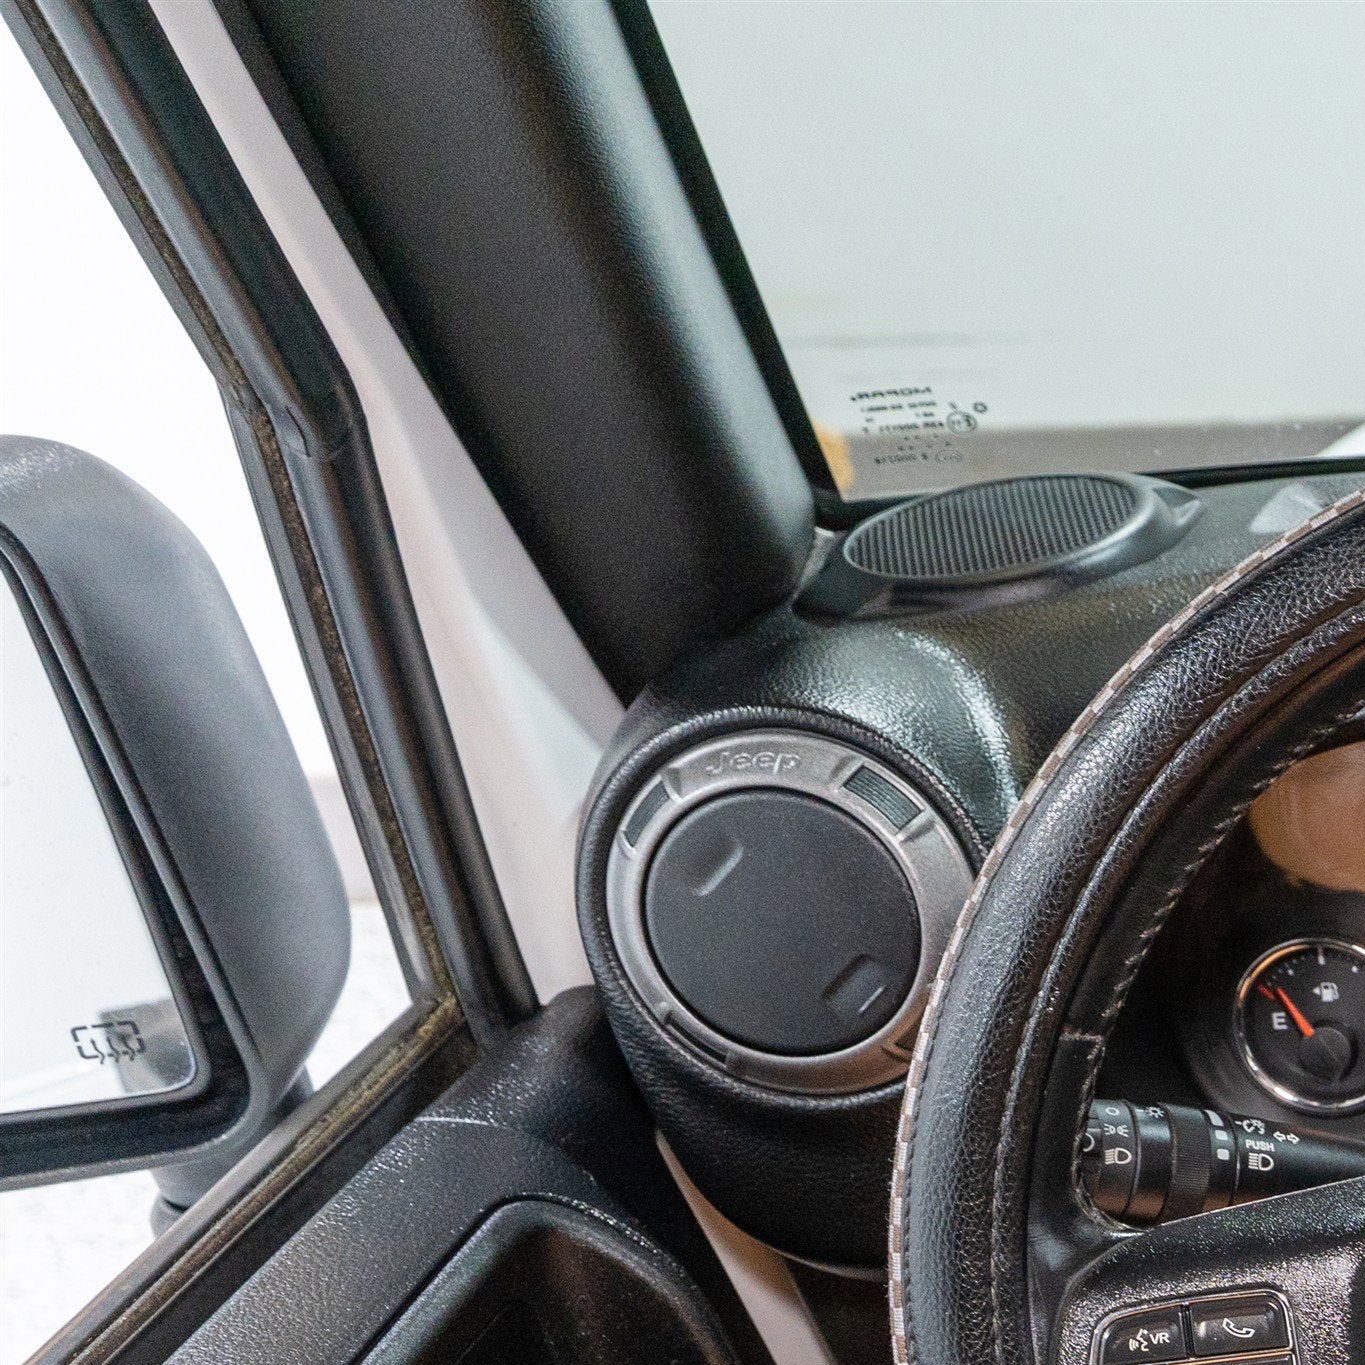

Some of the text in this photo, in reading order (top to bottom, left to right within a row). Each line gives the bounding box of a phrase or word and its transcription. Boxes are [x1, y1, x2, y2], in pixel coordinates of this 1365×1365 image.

[706, 750, 800, 775] Jeep
[1272, 1013, 1288, 1030] E
[1245, 1139, 1275, 1152] PUSH
[1150, 1332, 1170, 1345] VR
